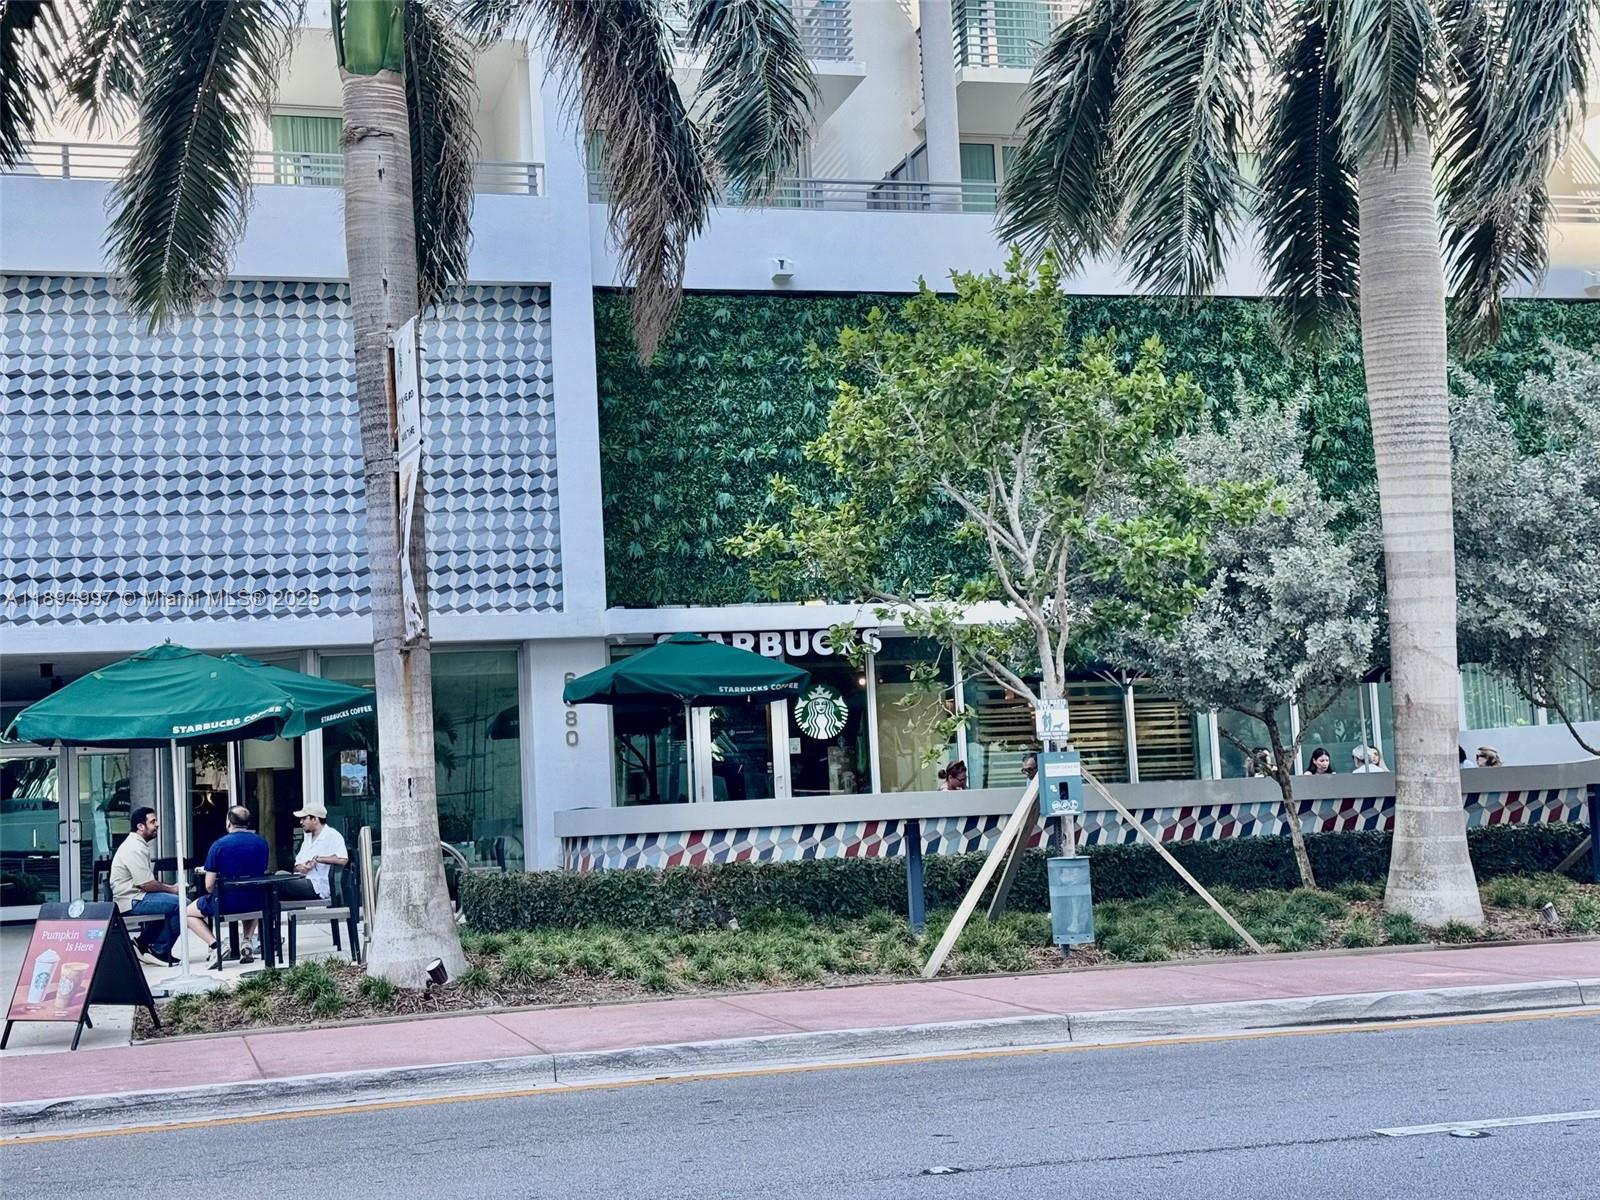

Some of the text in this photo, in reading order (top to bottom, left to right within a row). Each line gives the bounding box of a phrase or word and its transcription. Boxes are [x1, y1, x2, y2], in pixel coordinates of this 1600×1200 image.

[656, 627, 882, 657] RBUCS
[718, 685, 769, 693] STARBUCKS
[320, 704, 373, 724] STARBUCKS COFFEE
[172, 718, 241, 734] STARBUCKS
[41, 929, 80, 942] Pumpkin
[74, 941, 95, 952] Here
